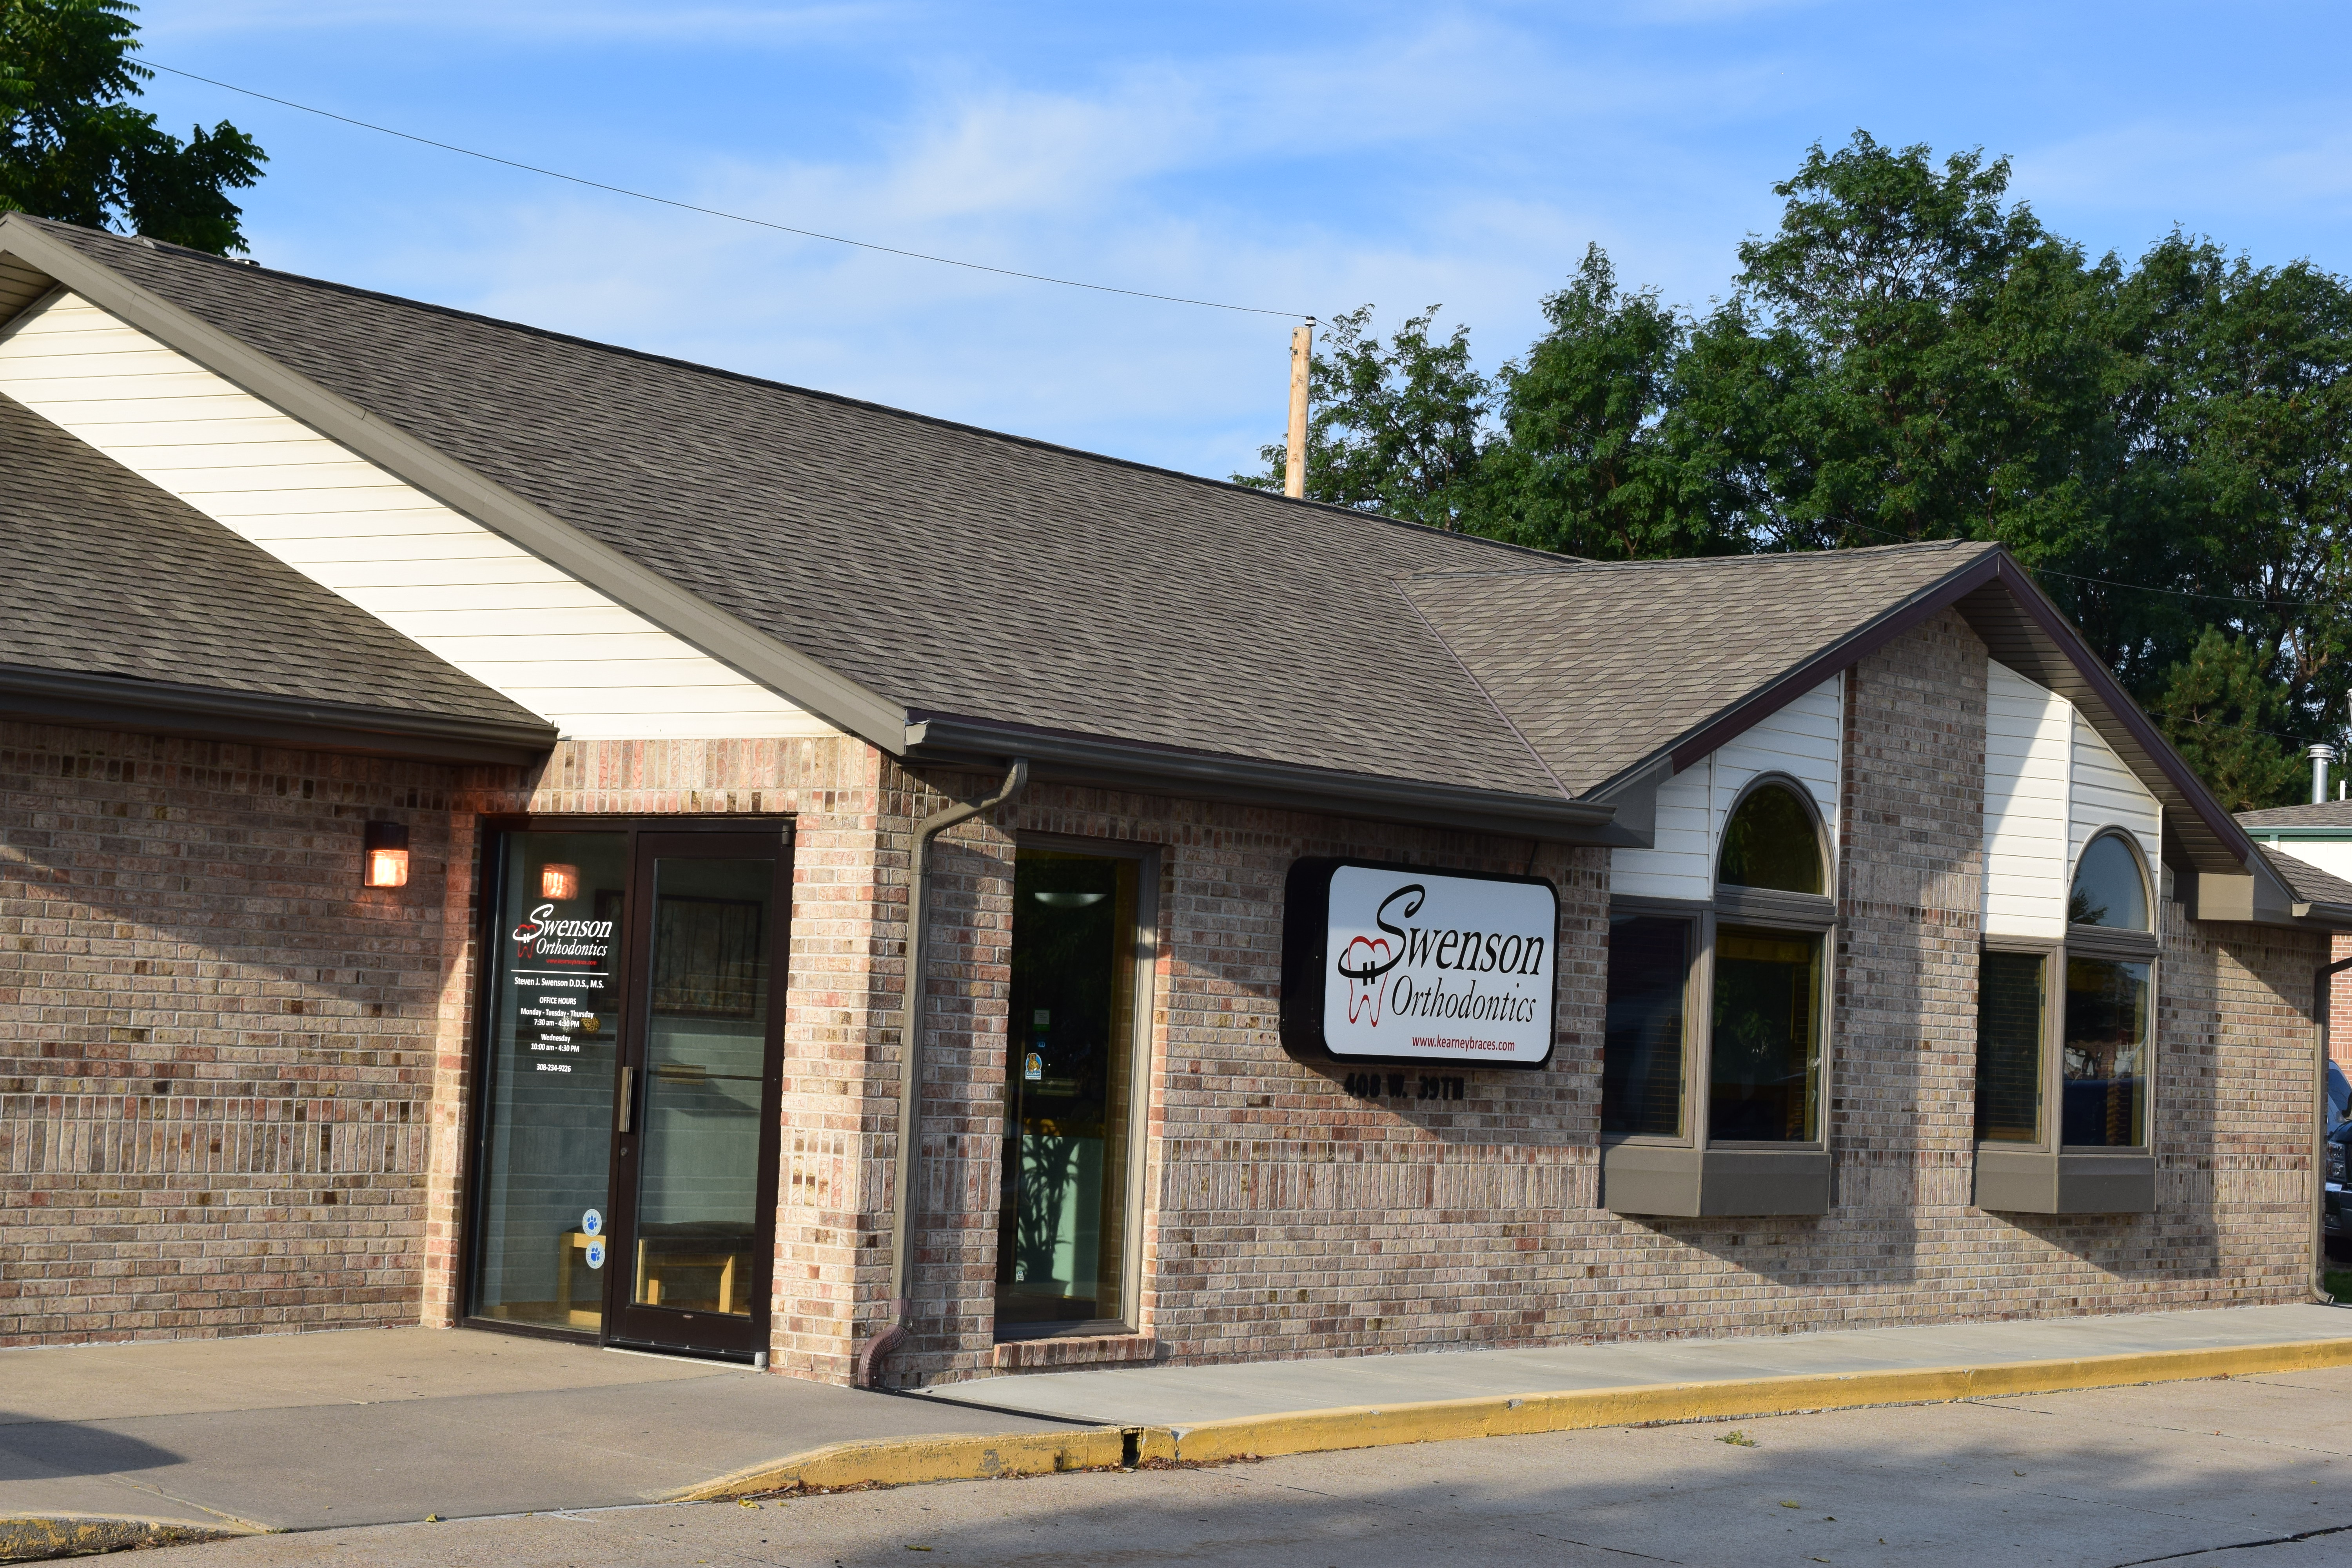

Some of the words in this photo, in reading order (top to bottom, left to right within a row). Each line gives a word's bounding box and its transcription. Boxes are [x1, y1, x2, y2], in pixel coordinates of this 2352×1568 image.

[513, 904, 612, 940] Swenson
[1338, 884, 1545, 979] Swenson
[536, 938, 608, 956] Orthodontics
[514, 977, 535, 985] Steven
[541, 978, 568, 987] Swenson
[569, 979, 589, 989] D.D.S.,
[590, 980, 604, 988] M.S.
[1391, 975, 1536, 1022] Orthodontics
[521, 1008, 542, 1017] Monday
[546, 1009, 566, 1019] Tuesday
[570, 1010, 594, 1019] Thursday
[541, 1033, 571, 1043] Wednesday
[1412, 1034, 1515, 1052] www.kearneybraces.com
[537, 1063, 571, 1072] 308-234-9226
[1343, 1073, 1381, 1098] 408
[1387, 1074, 1408, 1098] W.
[1417, 1076, 1465, 1100] 39TH
